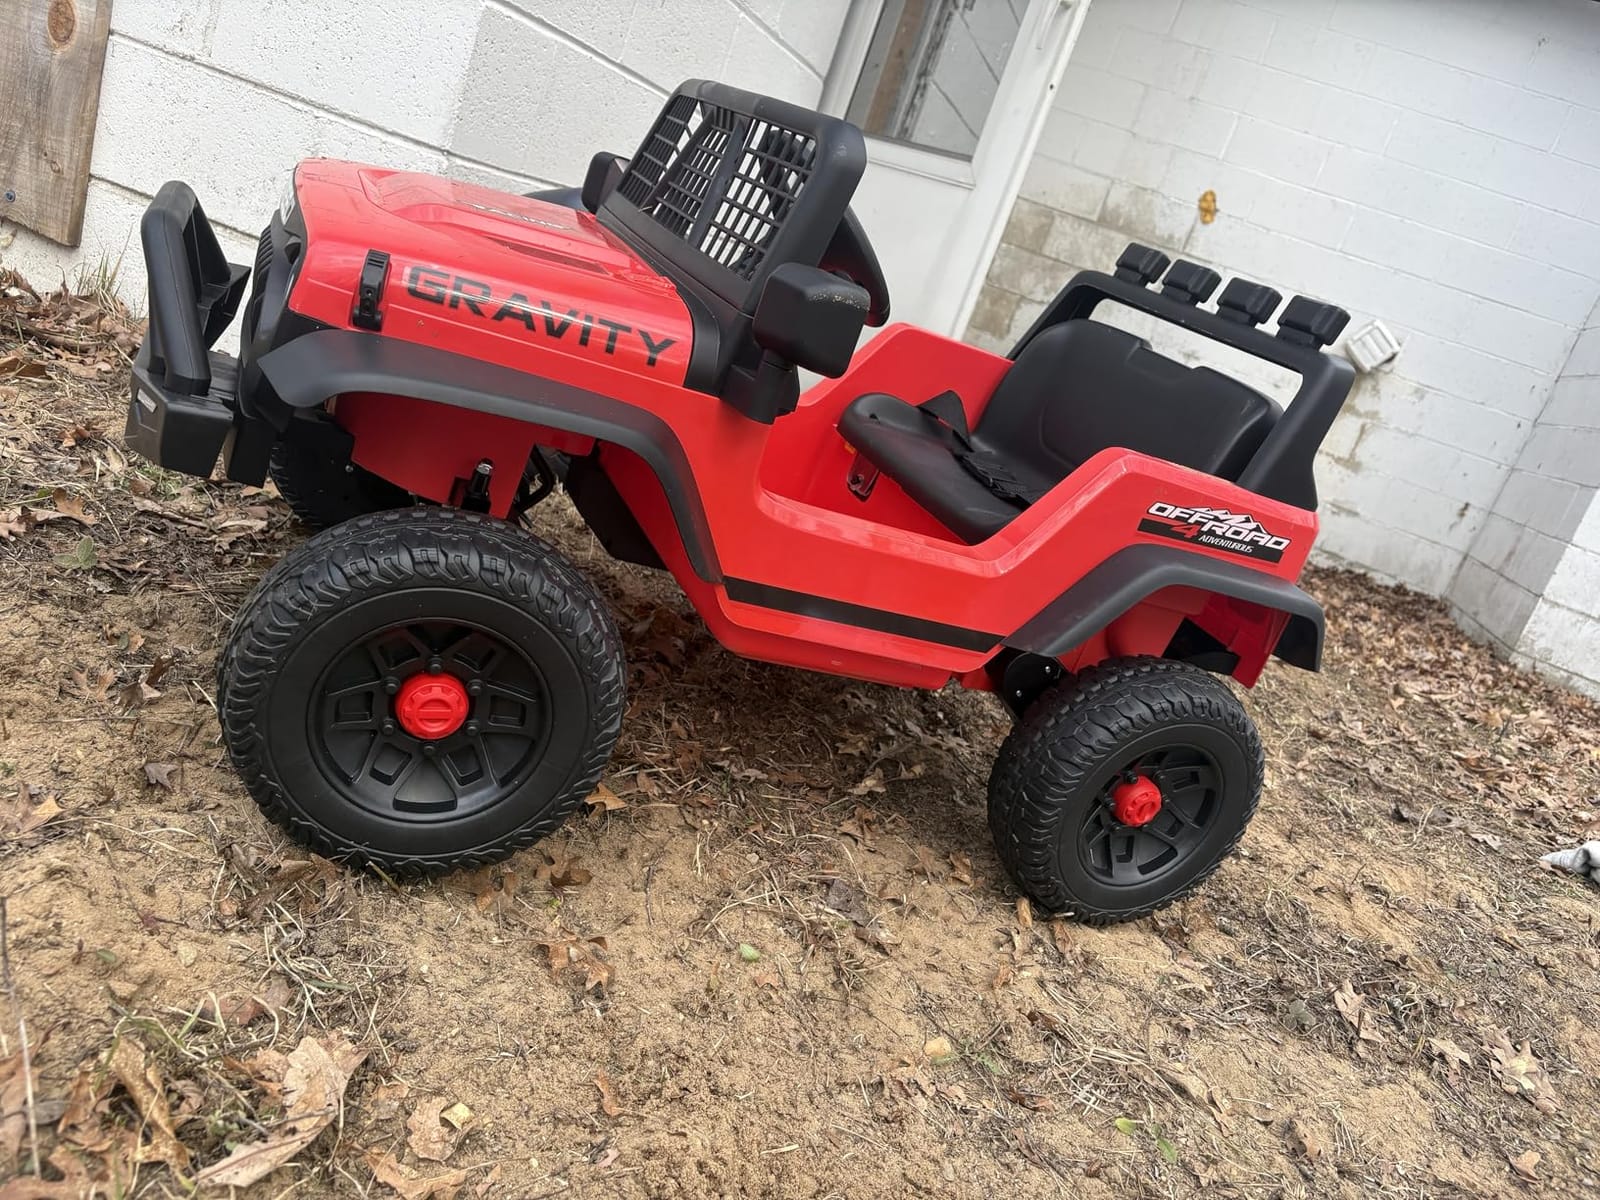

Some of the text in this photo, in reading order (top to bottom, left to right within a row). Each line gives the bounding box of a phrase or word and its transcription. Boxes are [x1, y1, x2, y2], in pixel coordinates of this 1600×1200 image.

[407, 265, 678, 368] GRAVITY
[1171, 525, 1255, 553] 4 ADVENTUROUS
